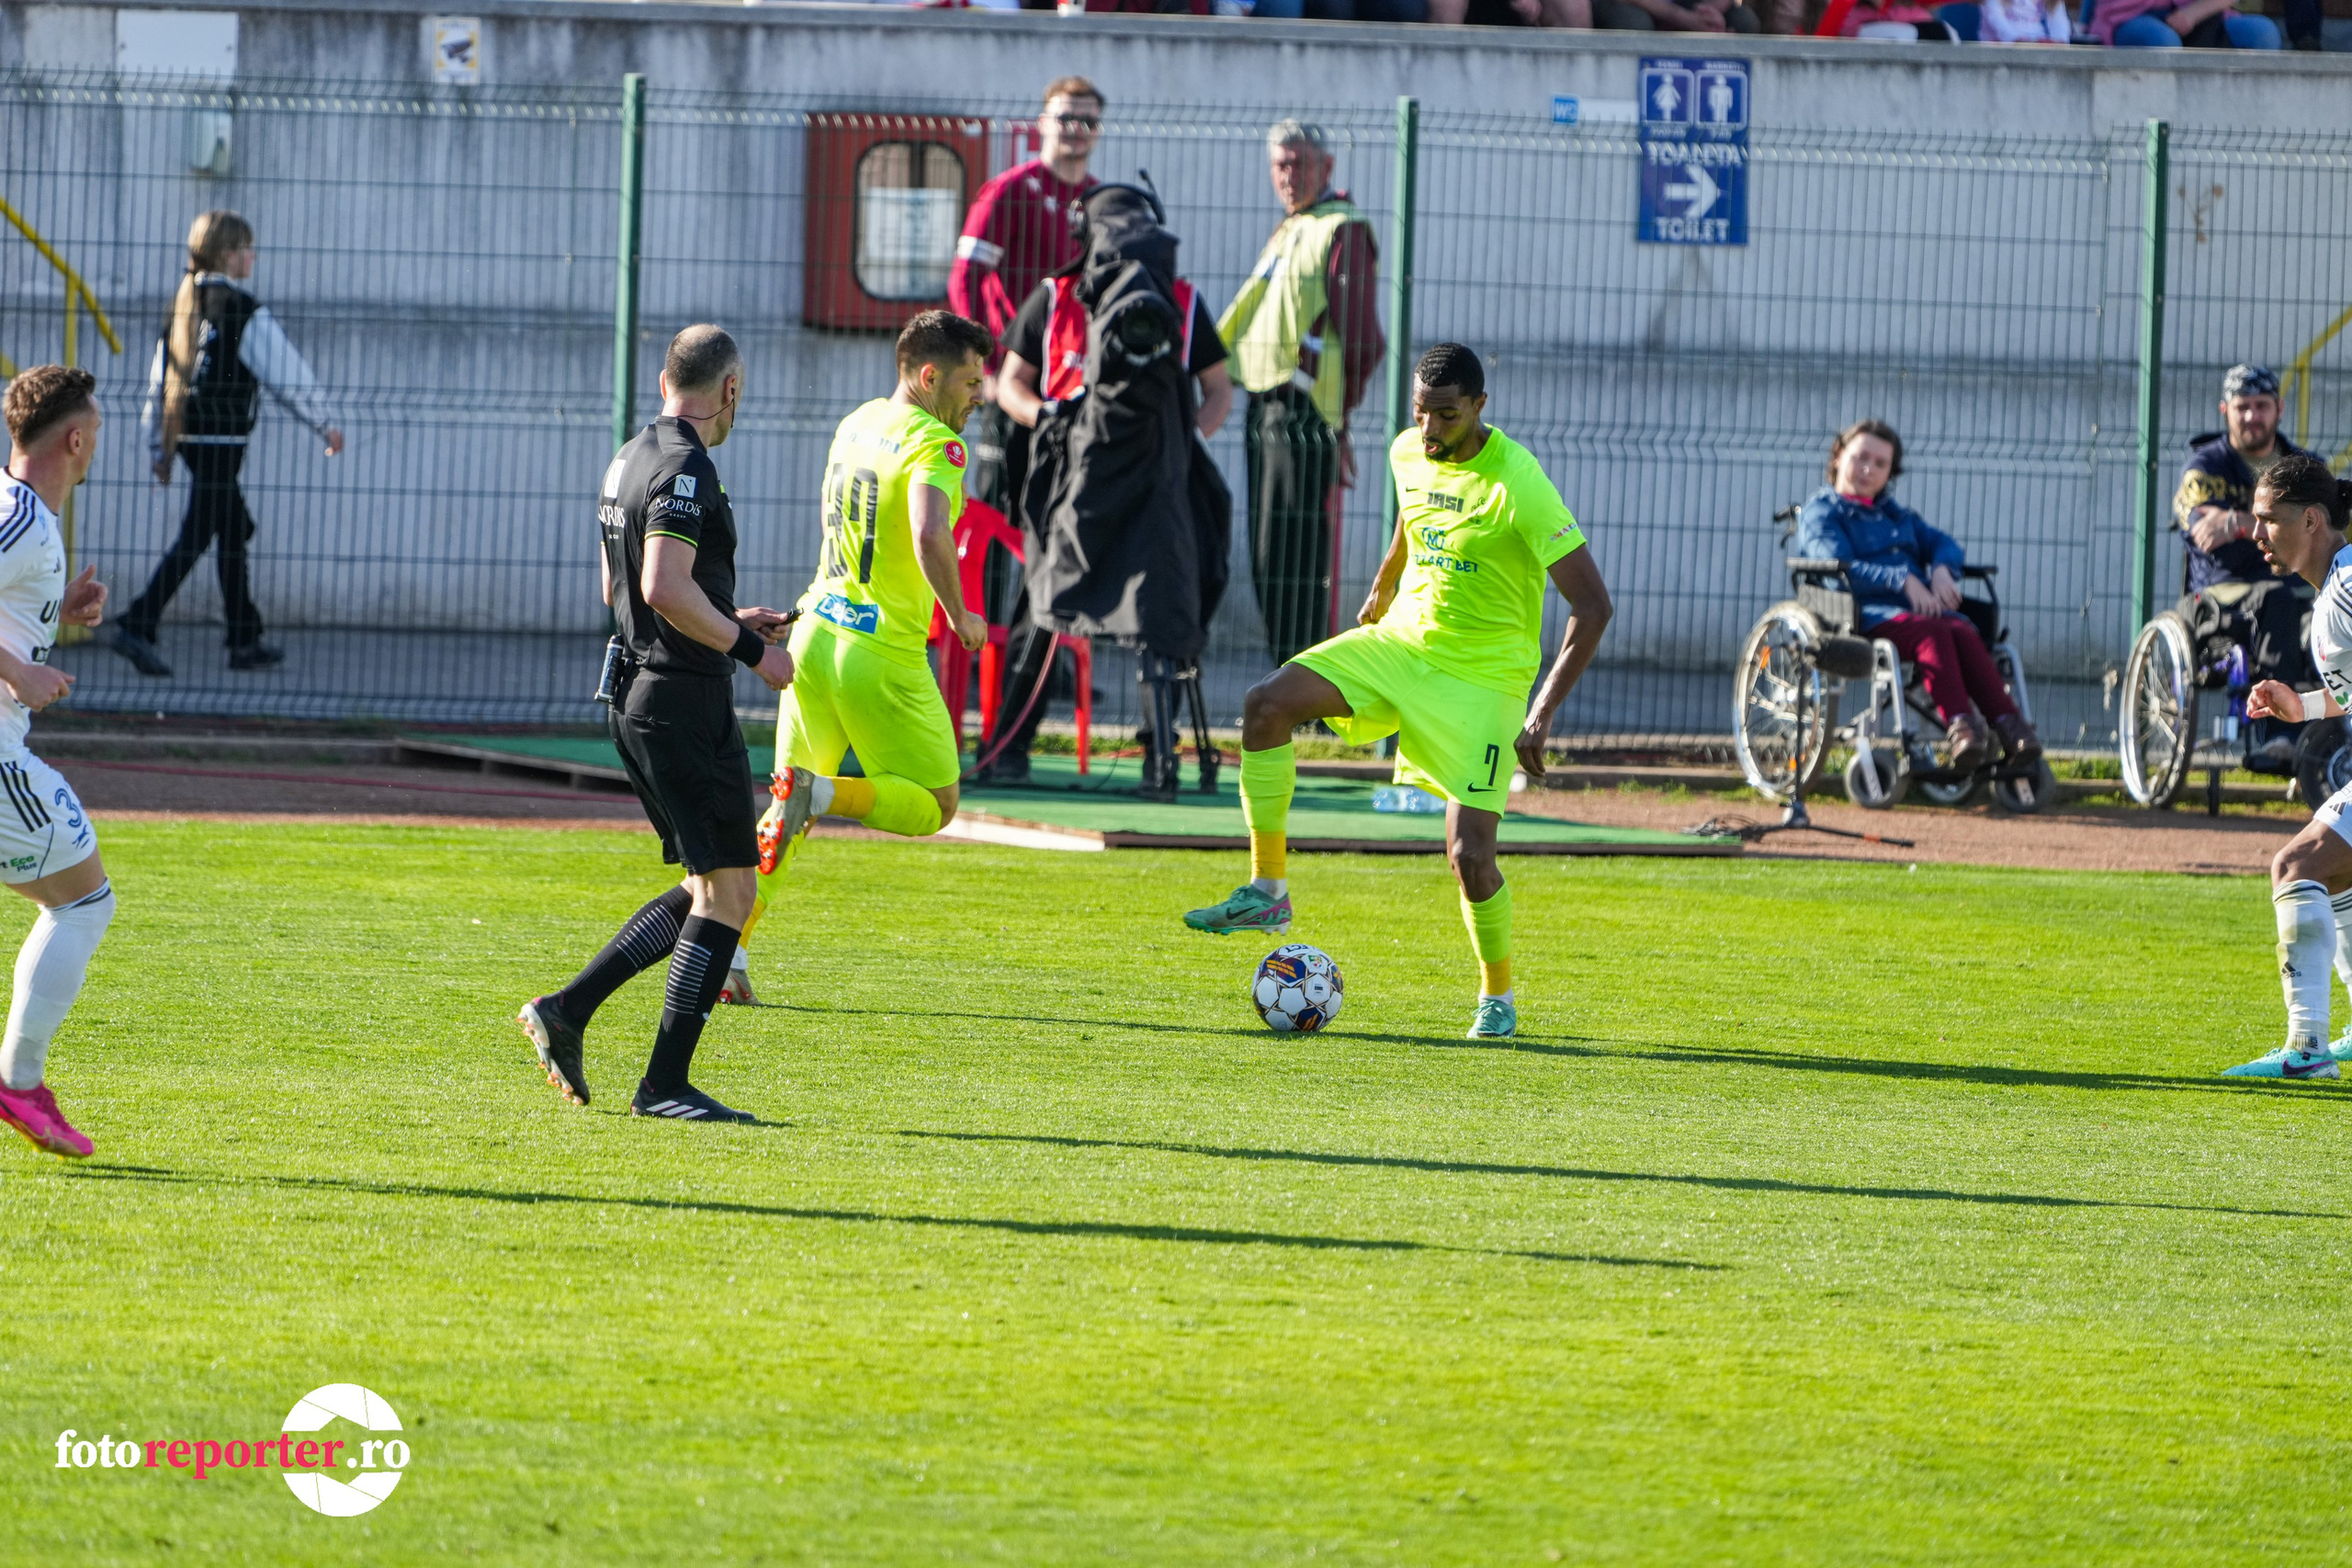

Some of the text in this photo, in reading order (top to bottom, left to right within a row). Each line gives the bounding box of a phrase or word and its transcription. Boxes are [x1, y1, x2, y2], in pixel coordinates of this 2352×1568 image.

[1656, 217, 1729, 242] TOILET
[827, 463, 878, 583] 37
[1455, 559, 1478, 573] BET
[1485, 743, 1499, 786] 7
[10, 855, 34, 867] Eco
